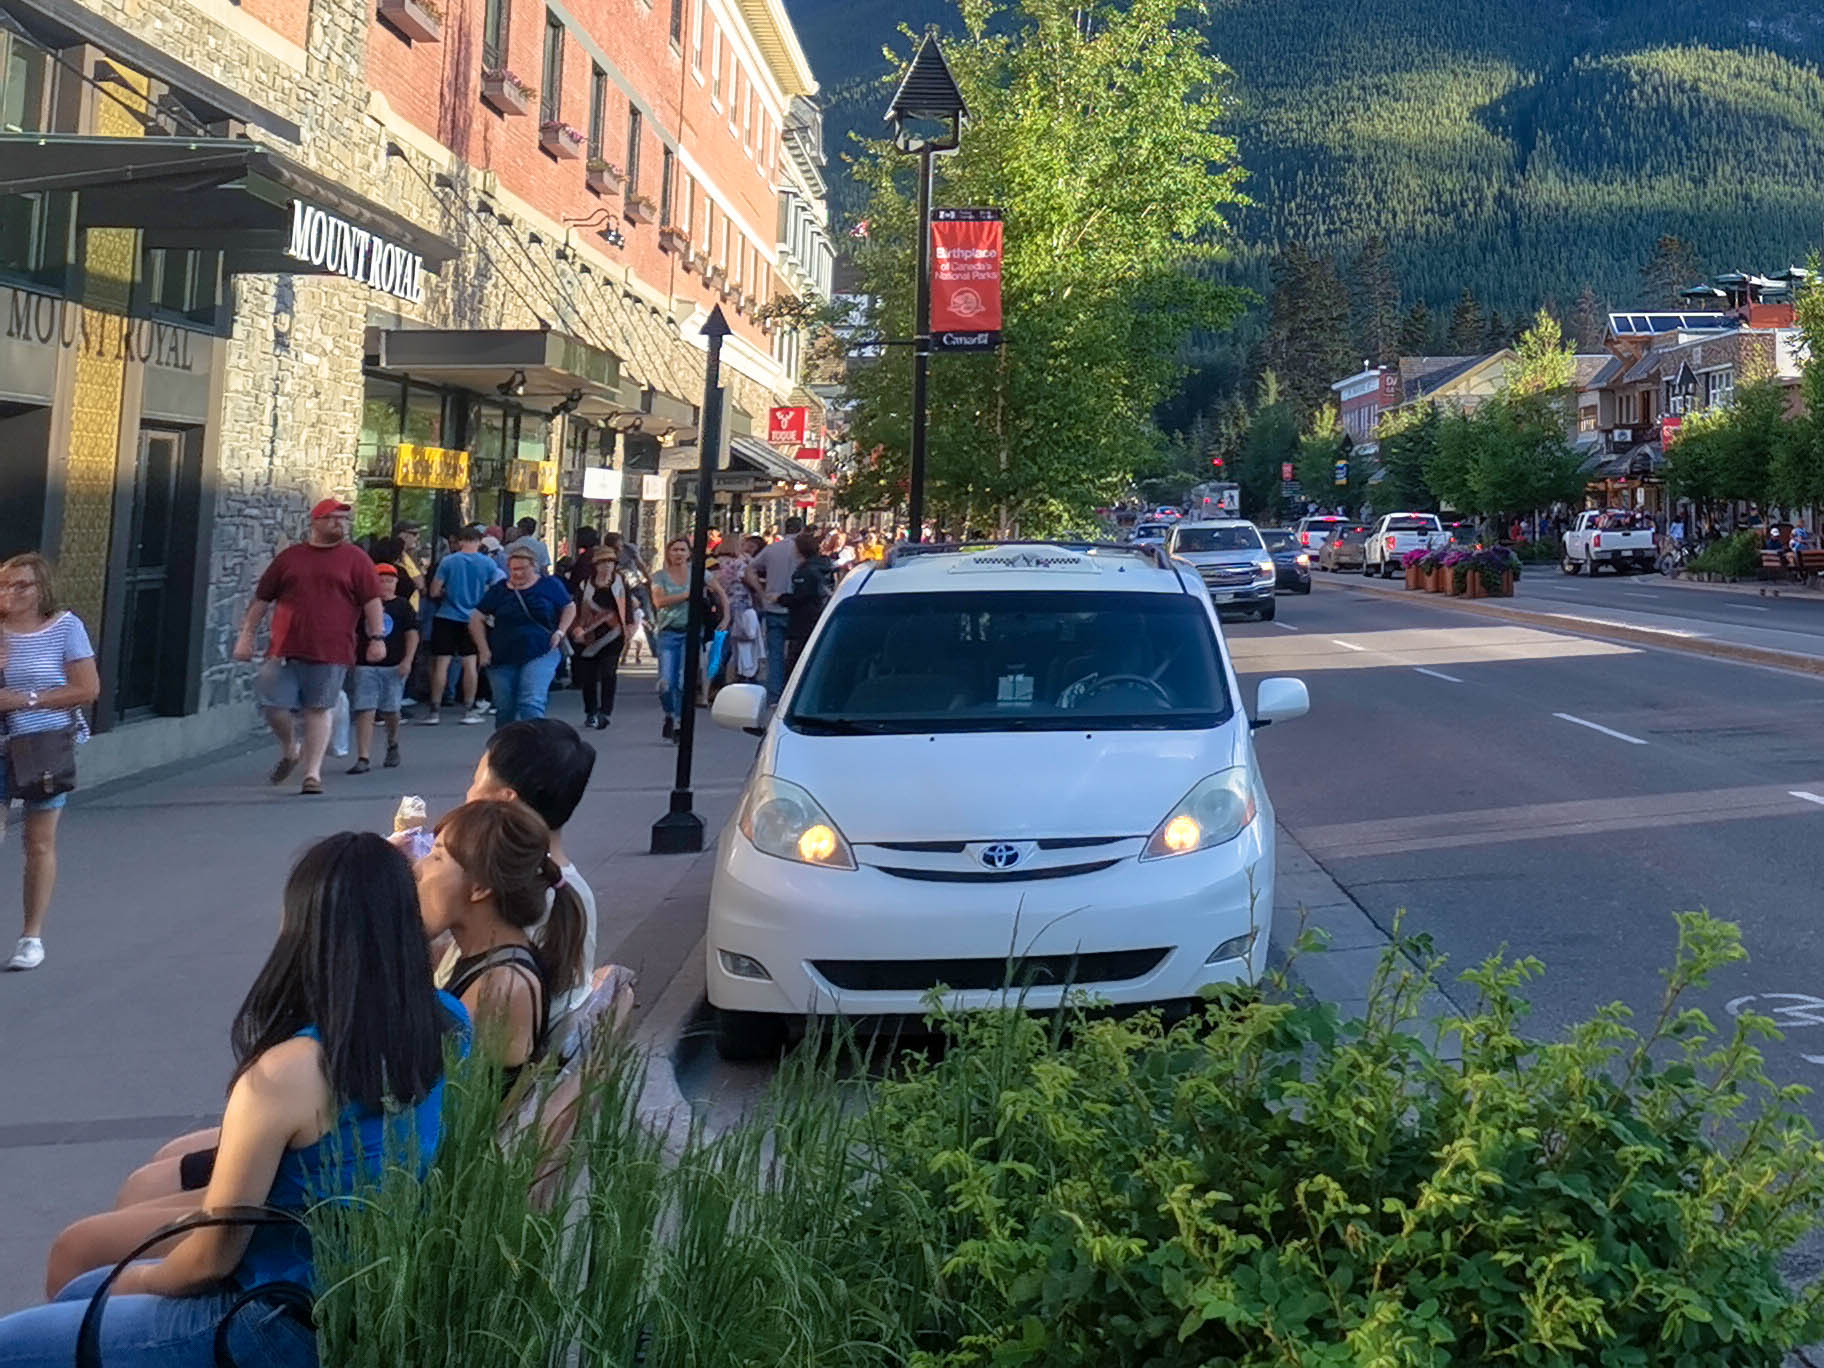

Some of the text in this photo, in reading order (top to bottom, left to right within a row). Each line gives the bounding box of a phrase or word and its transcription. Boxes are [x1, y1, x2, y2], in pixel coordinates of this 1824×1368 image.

[288, 199, 423, 304] MOUNT ROYAL
[936, 247, 997, 260] Birthplace
[941, 262, 950, 271] of
[935, 271, 999, 280] National Parks
[116, 315, 193, 370] ROYAL
